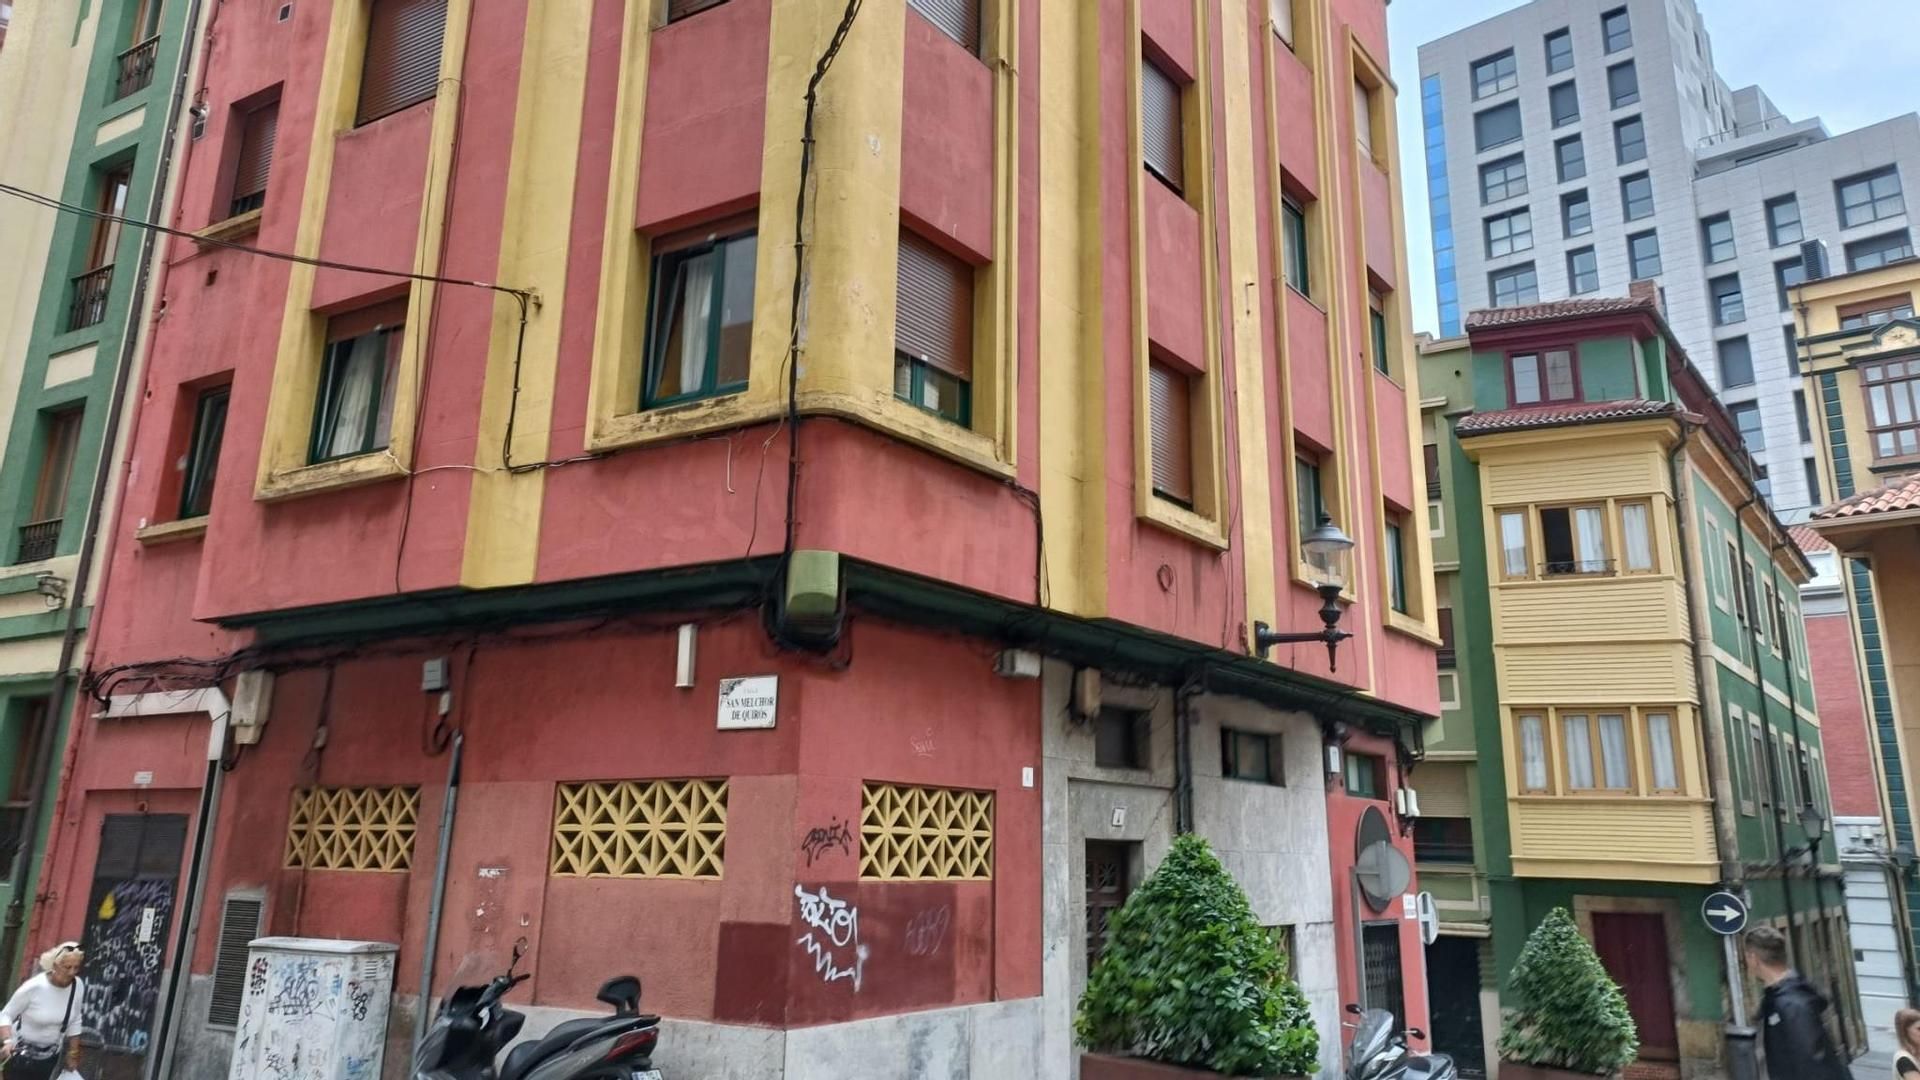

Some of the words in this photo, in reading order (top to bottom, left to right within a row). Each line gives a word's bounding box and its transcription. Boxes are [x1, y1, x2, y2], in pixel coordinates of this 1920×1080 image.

[727, 698, 739, 708] SAN
[741, 697, 774, 707] MELCHOR
[731, 710, 741, 720] DE
